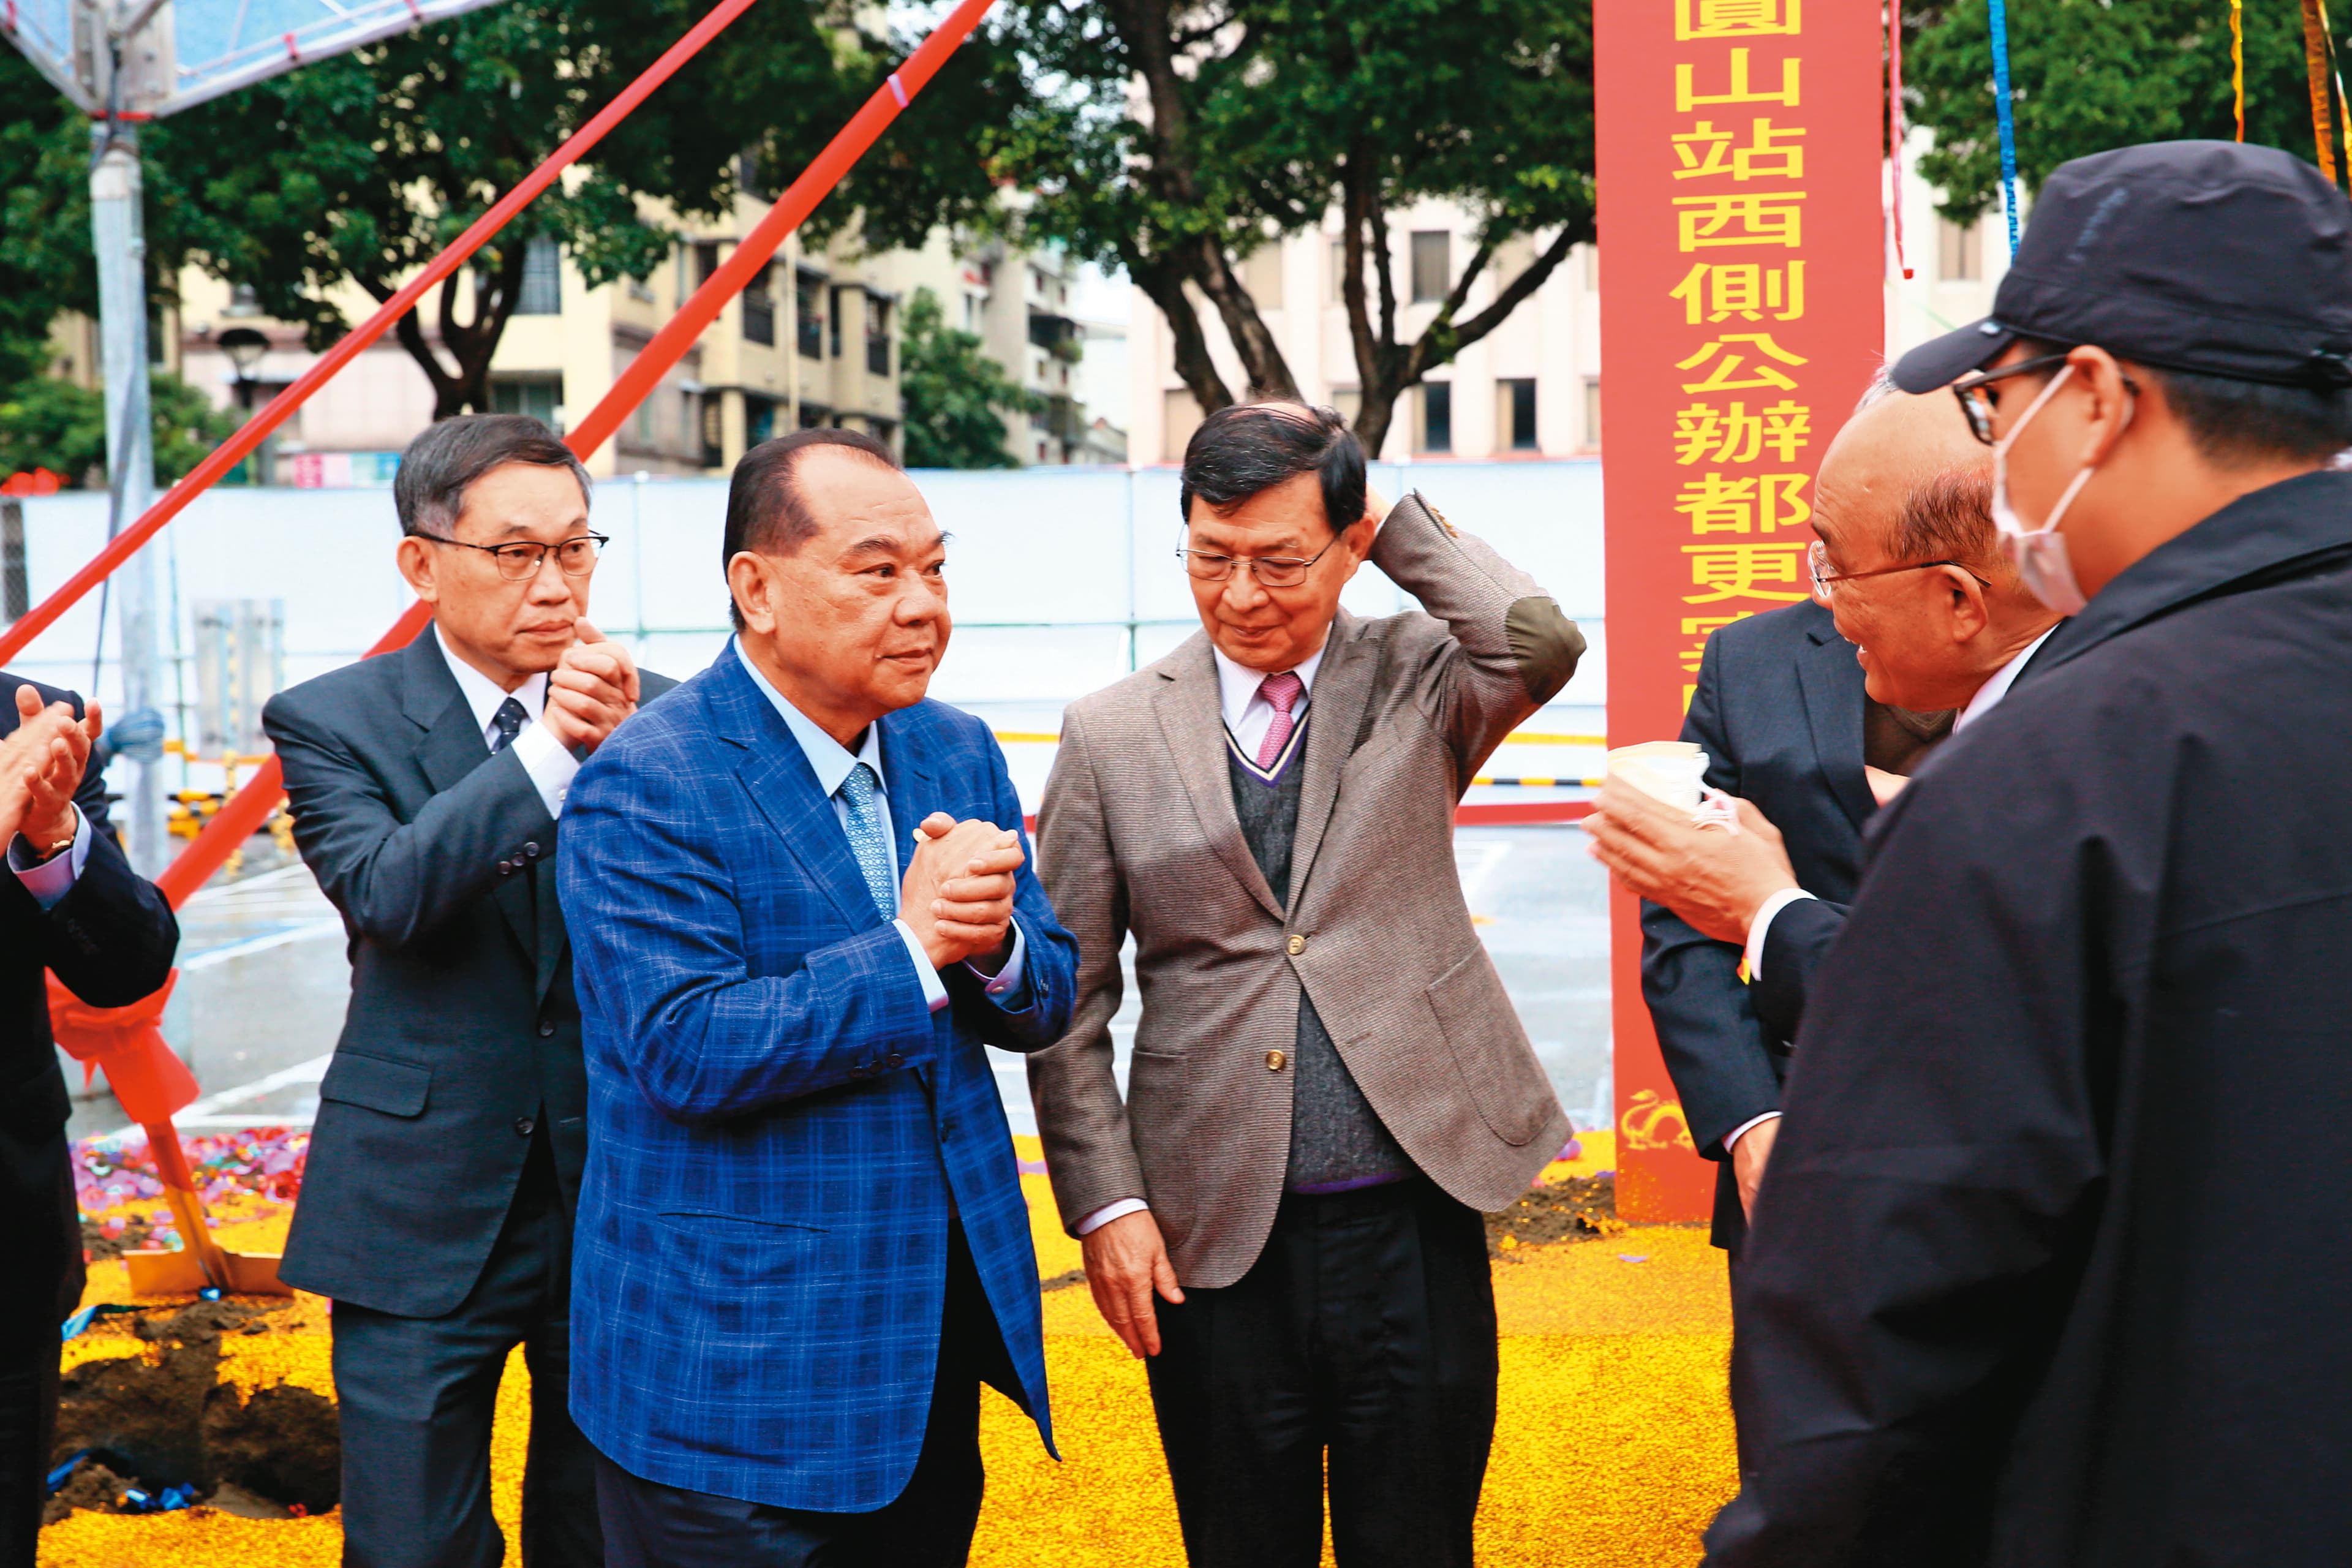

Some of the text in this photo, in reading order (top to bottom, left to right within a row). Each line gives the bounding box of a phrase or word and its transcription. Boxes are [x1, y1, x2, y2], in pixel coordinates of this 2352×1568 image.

[1669, 0, 1811, 716] 圓山站西側公辦都更
